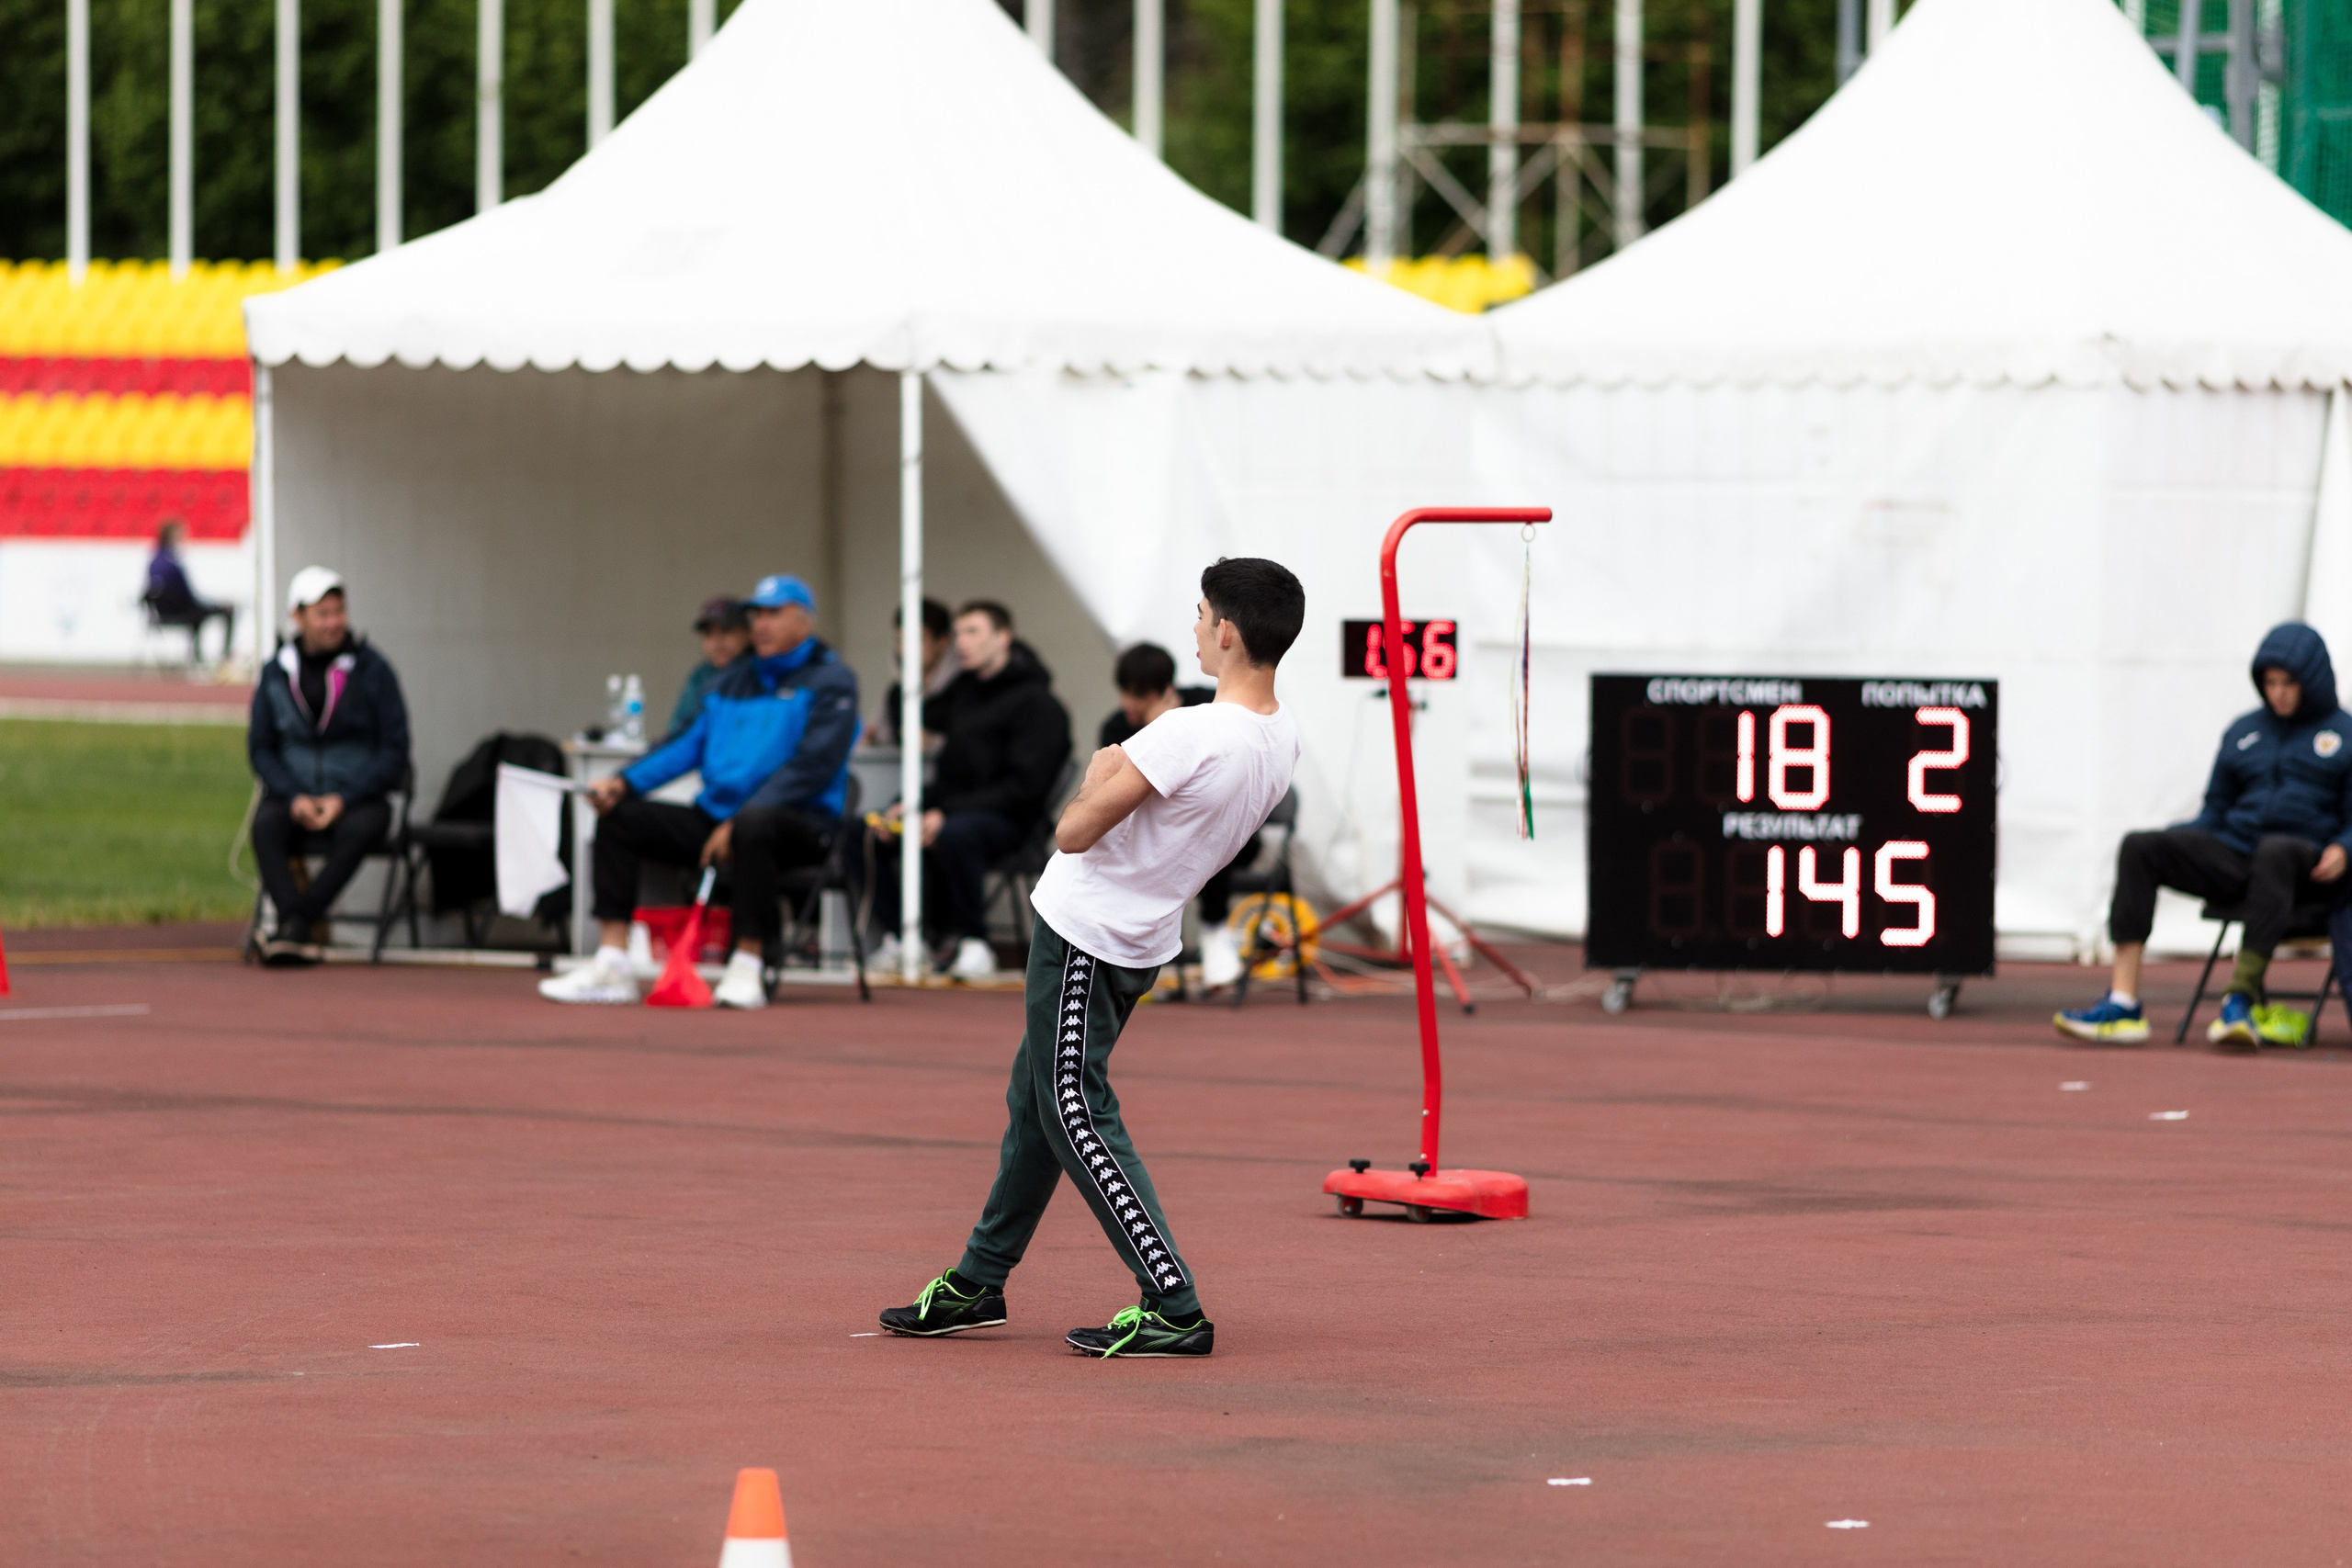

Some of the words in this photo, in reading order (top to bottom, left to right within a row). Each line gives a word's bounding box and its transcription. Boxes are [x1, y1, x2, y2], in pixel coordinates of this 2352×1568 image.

[1646, 678, 1804, 705] СПОРТСМЕН
[1861, 681, 1988, 708] ПОПЫТКА
[1736, 705, 1830, 810] 18
[1907, 706, 1970, 812] 2
[1722, 811, 1862, 840] РЕЗУЛЬТАТ
[1766, 840, 1935, 946] 145
